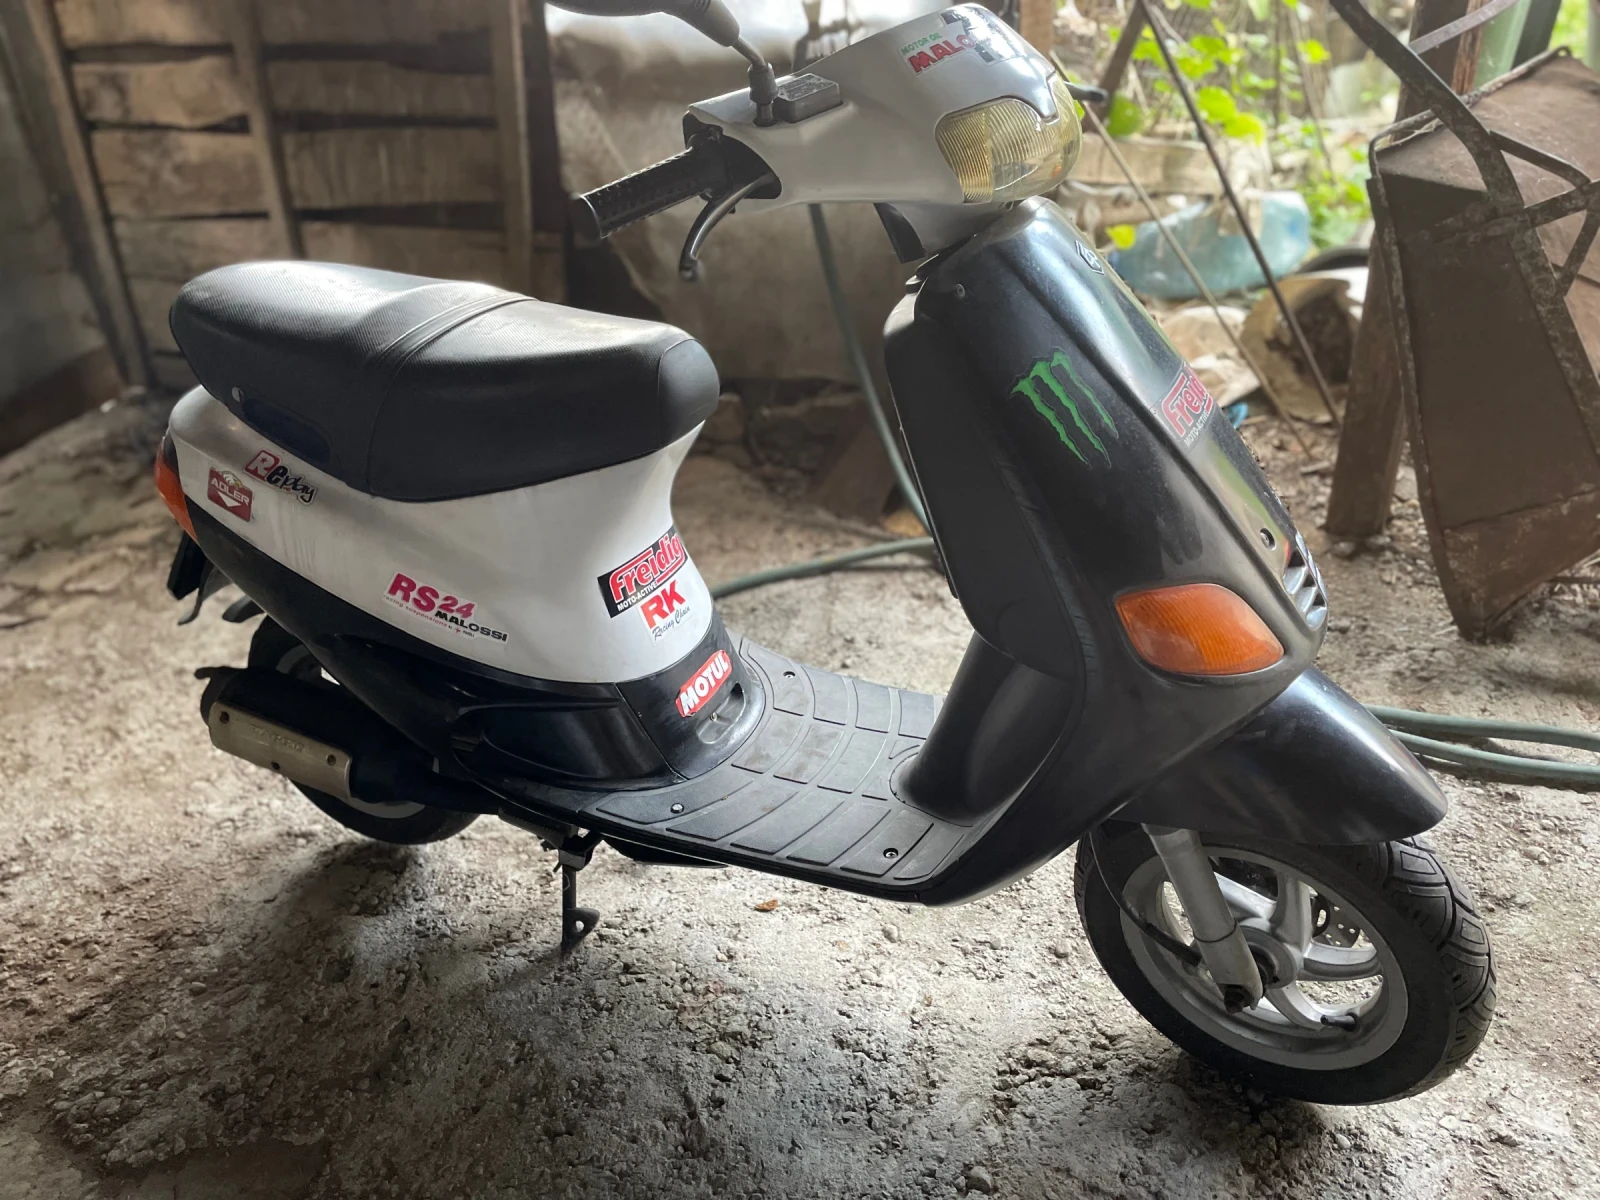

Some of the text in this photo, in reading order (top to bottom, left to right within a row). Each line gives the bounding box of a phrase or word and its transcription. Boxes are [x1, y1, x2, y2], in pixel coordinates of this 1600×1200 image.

[901, 31, 942, 56] MOTOR OIL
[907, 34, 977, 73] MALO
[211, 478, 249, 506] ADLER
[244, 450, 317, 504] Replay
[609, 533, 686, 603] Freidig
[616, 580, 658, 613] MOTO-ACTIVE
[640, 580, 686, 629] RK
[435, 610, 507, 641] MALOSSI
[652, 605, 691, 641] Racing Chain
[680, 654, 730, 716] MOTUL
